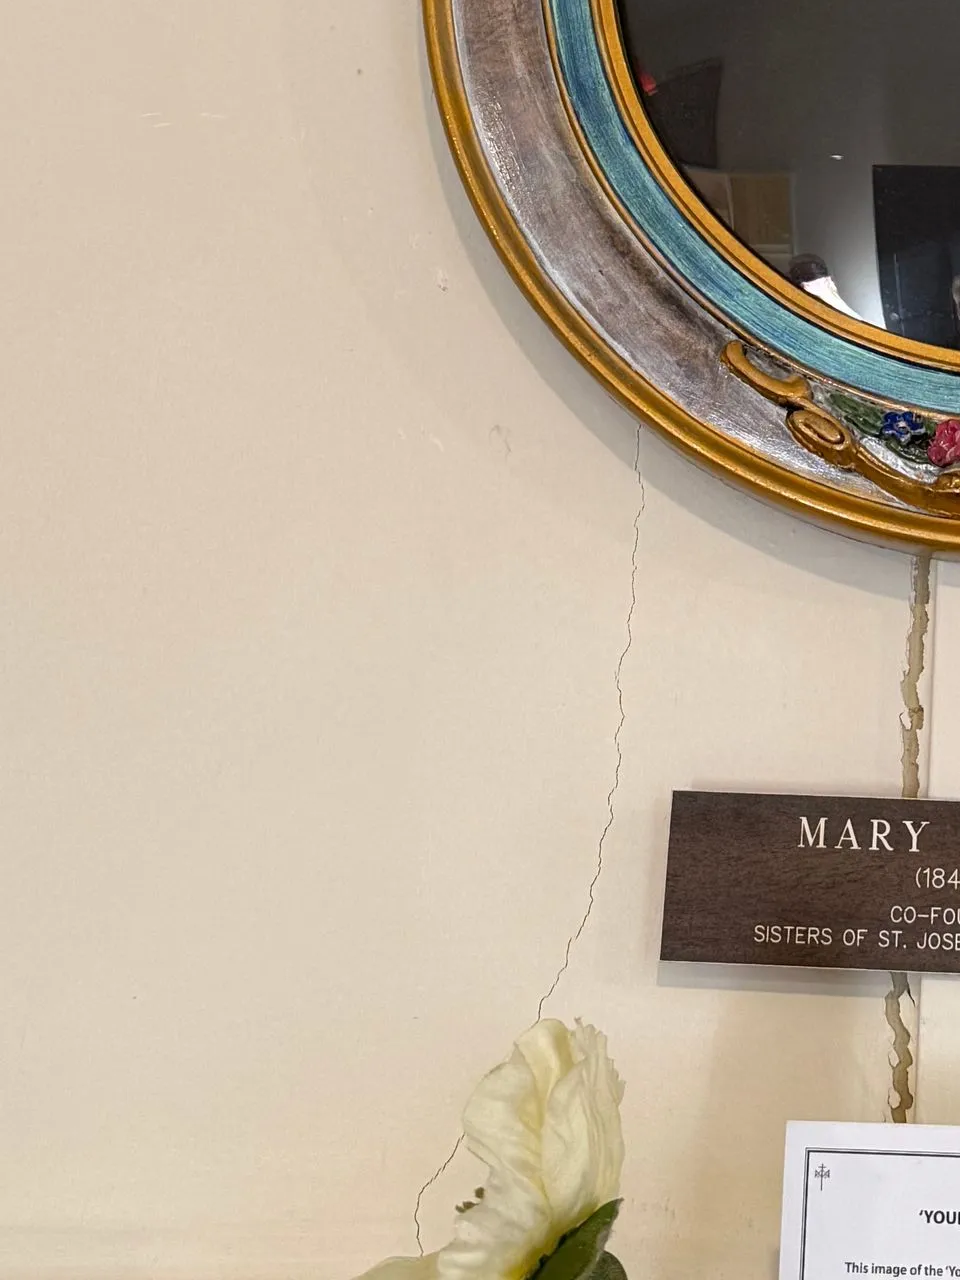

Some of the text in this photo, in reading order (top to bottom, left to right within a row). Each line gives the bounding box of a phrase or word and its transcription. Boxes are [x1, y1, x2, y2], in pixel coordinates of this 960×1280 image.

[797, 816, 930, 853] MARY
[754, 924, 833, 945] SISTERS
[842, 928, 868, 947] OF
[878, 929, 907, 948] ST.
[844, 1261, 869, 1274] This
[871, 1262, 907, 1278] image
[909, 1264, 923, 1276] of
[924, 1264, 944, 1277] the
